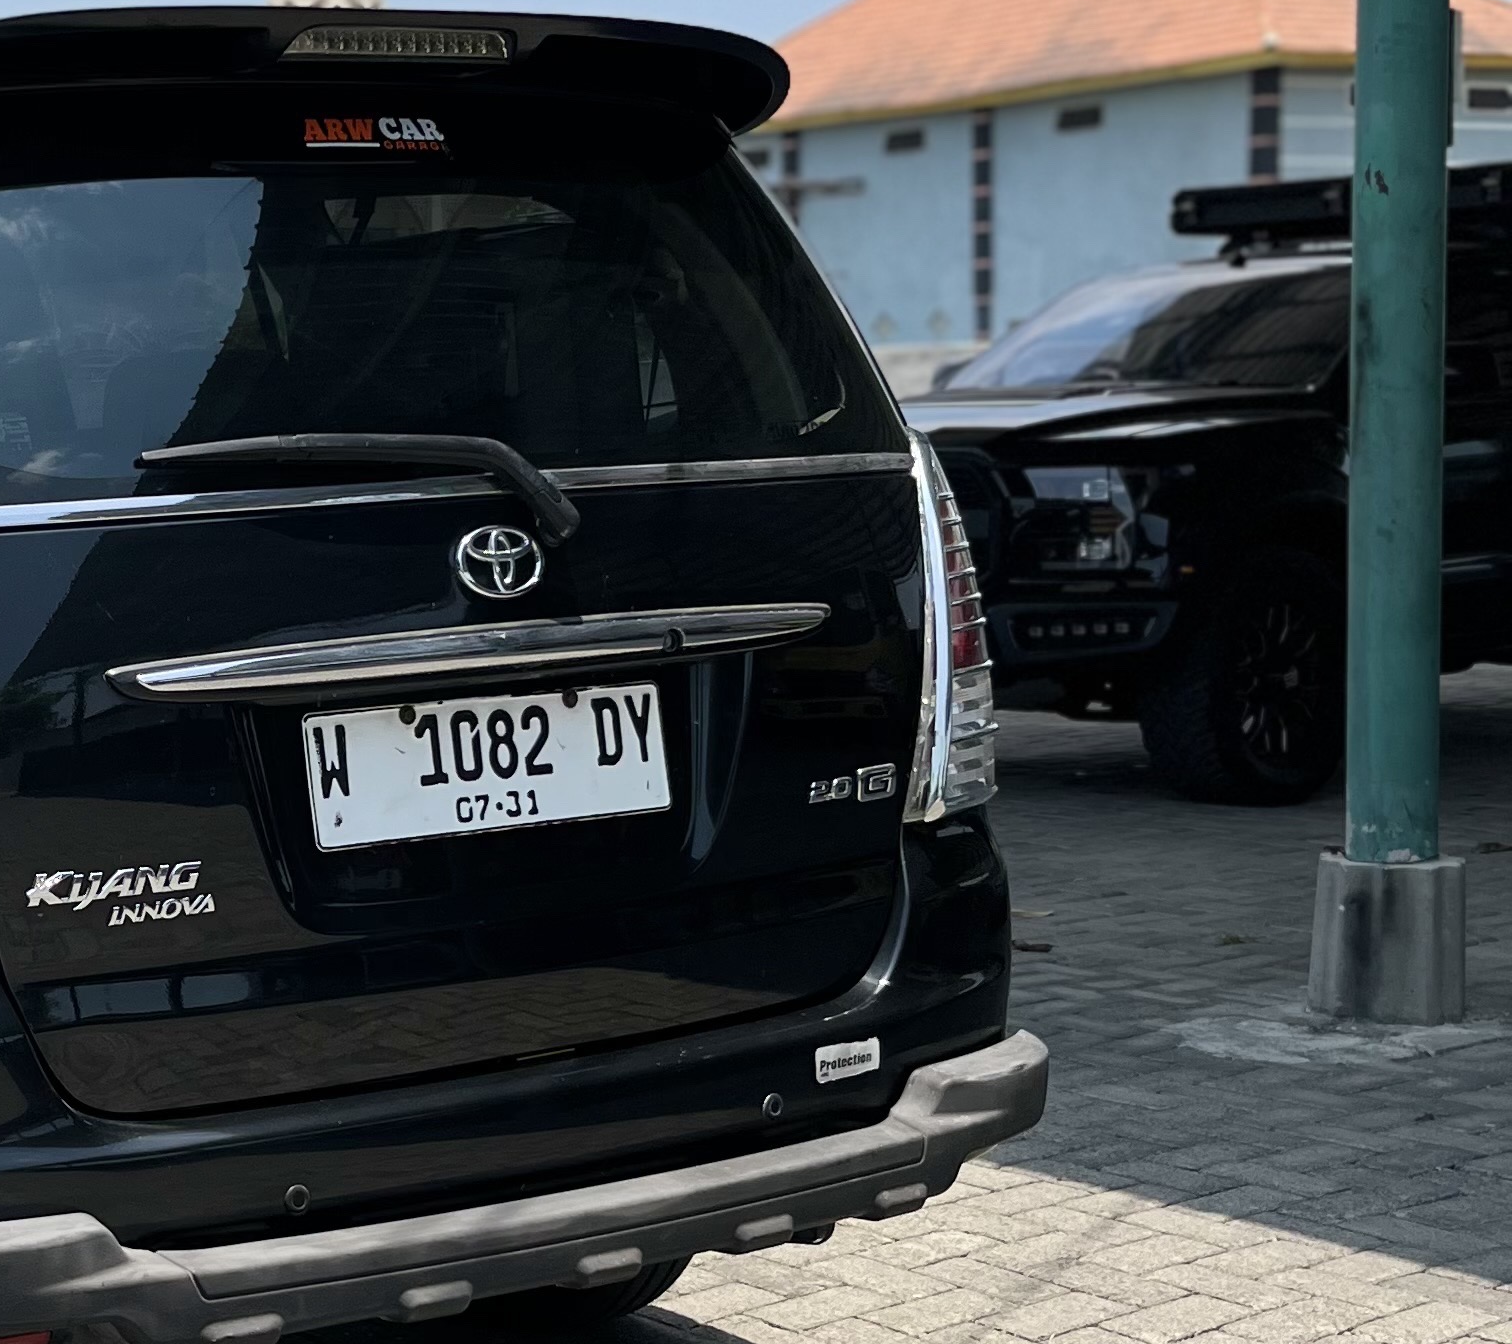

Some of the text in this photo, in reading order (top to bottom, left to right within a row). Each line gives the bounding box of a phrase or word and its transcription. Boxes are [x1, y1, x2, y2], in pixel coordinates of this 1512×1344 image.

[304, 117, 445, 141] ARW CAR
[313, 693, 651, 799] W 1082 DY
[819, 1053, 872, 1072] Protection
